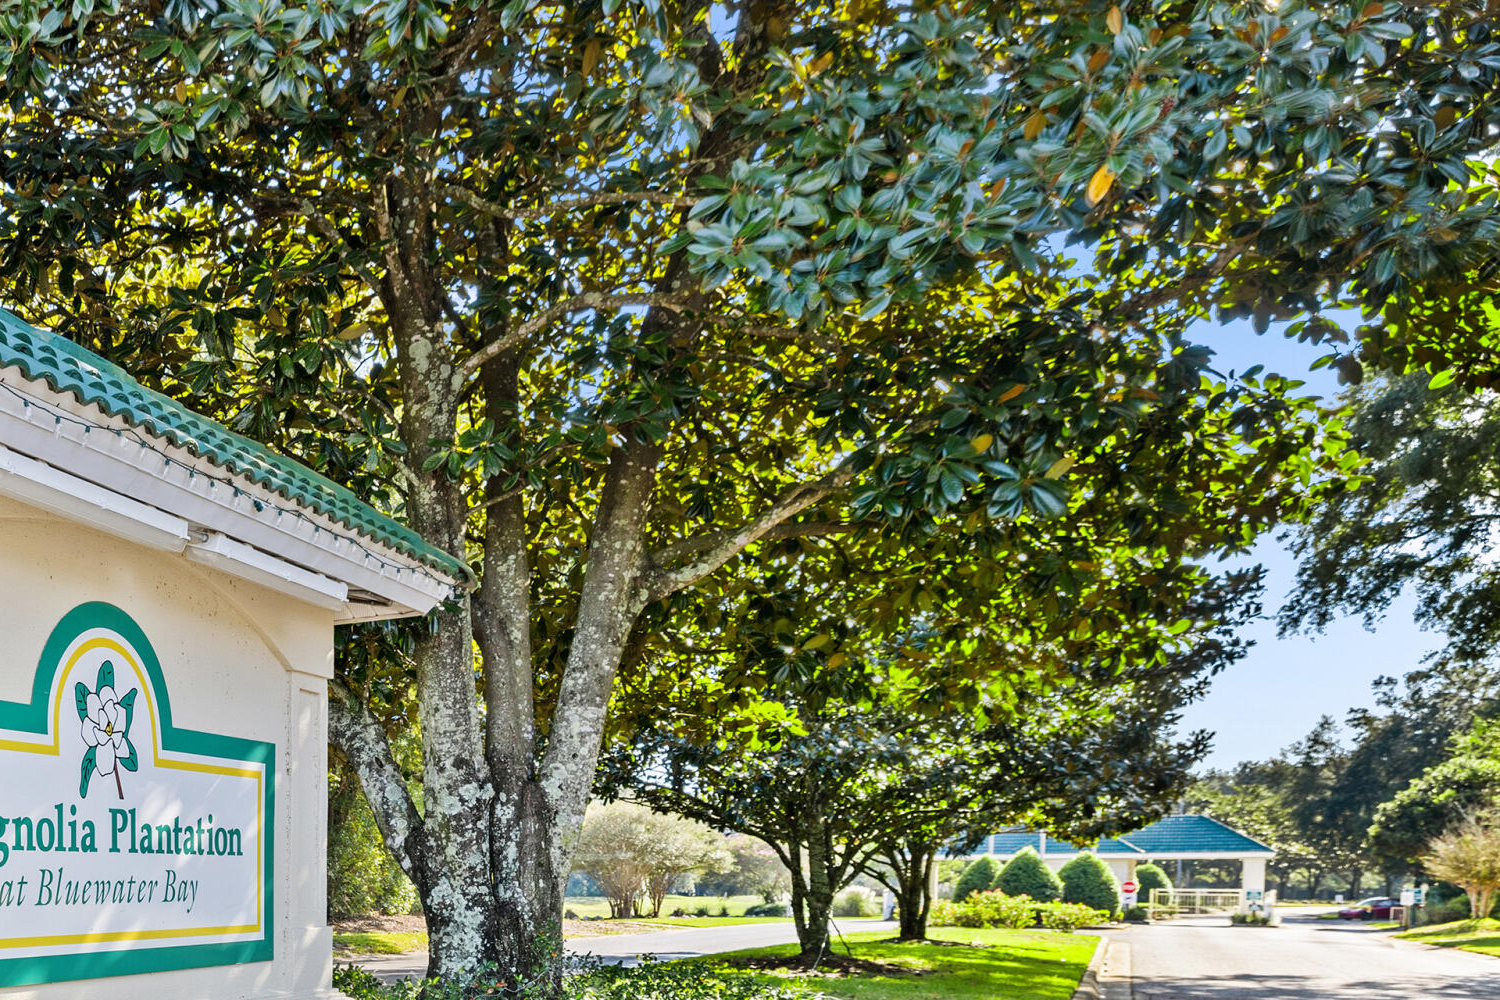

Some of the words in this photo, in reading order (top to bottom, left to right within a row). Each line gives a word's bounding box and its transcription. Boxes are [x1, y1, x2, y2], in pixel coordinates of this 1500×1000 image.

[108, 808, 243, 856] Plantation
[35, 868, 158, 906] Bluewater
[162, 869, 198, 913] Bay
